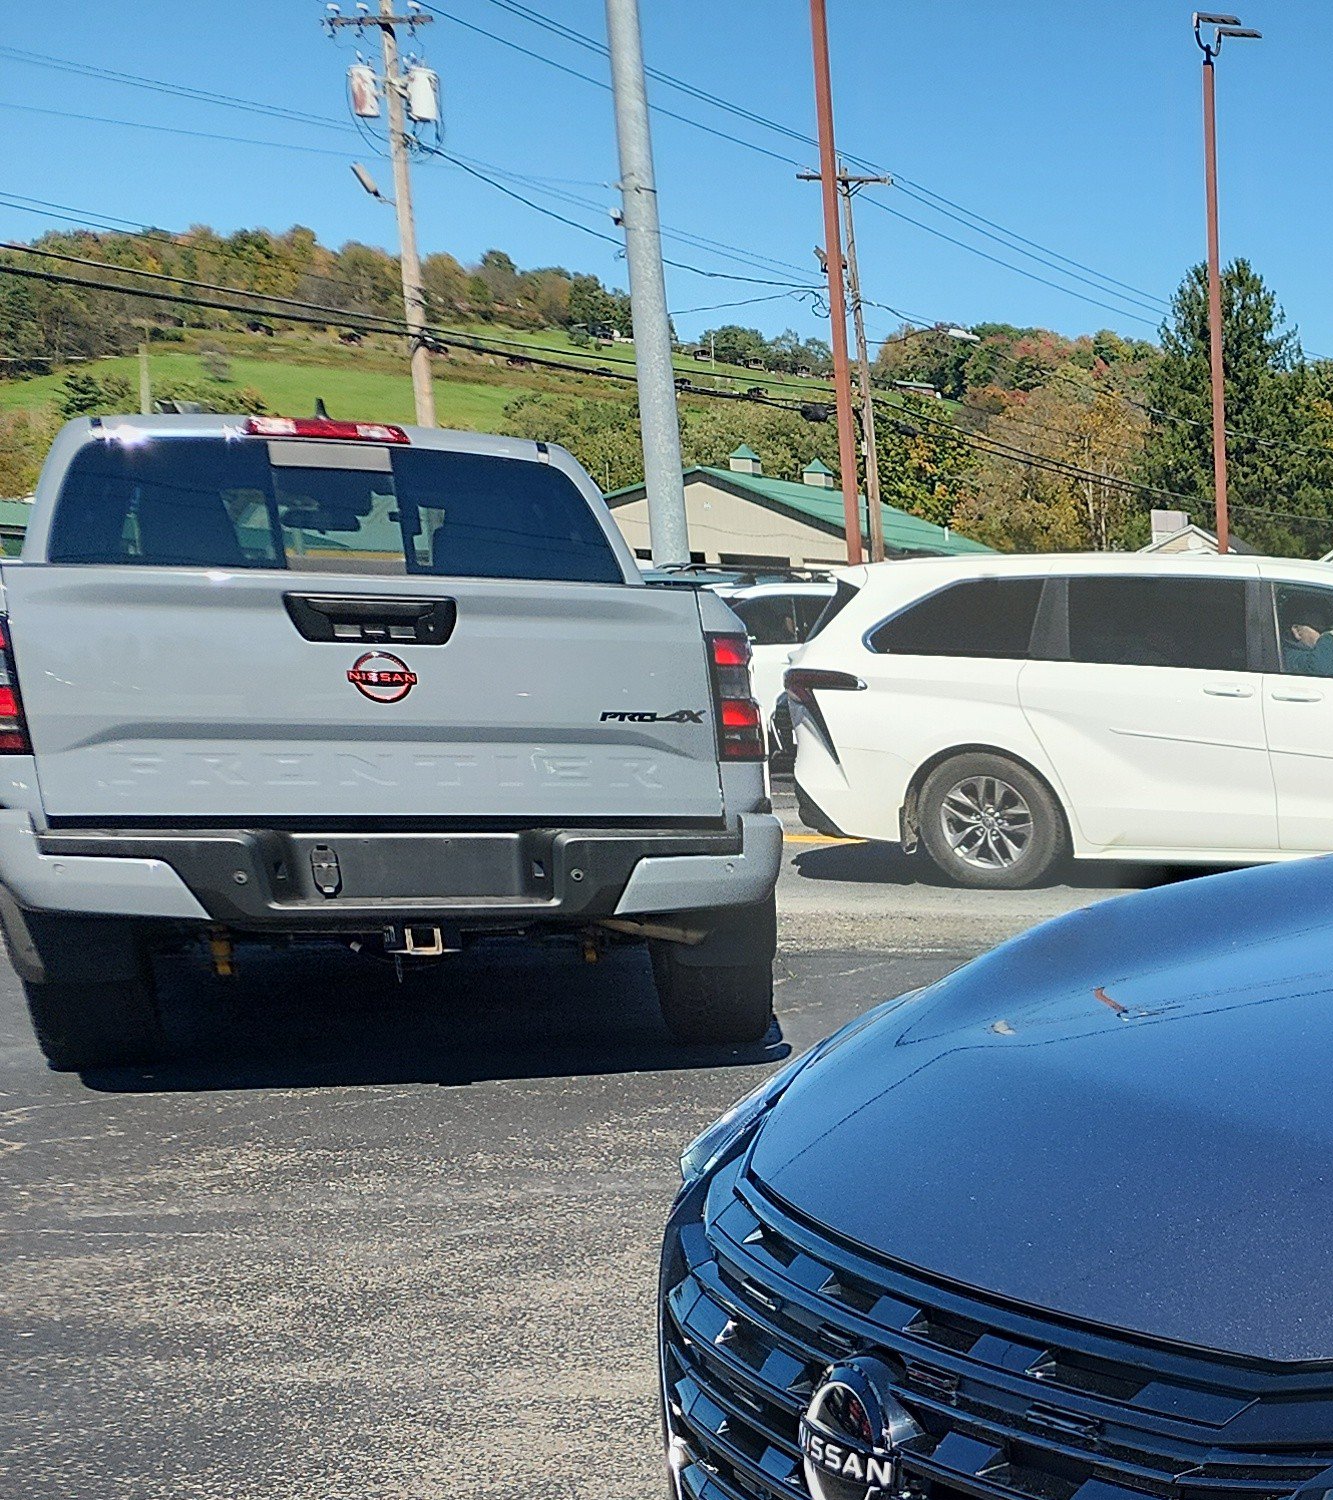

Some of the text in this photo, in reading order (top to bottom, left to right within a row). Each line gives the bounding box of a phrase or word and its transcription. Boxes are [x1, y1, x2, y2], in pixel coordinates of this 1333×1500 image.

[349, 671, 416, 682] NISSAN
[98, 750, 665, 789] FRONTIER
[799, 1420, 892, 1487] NISSAN
